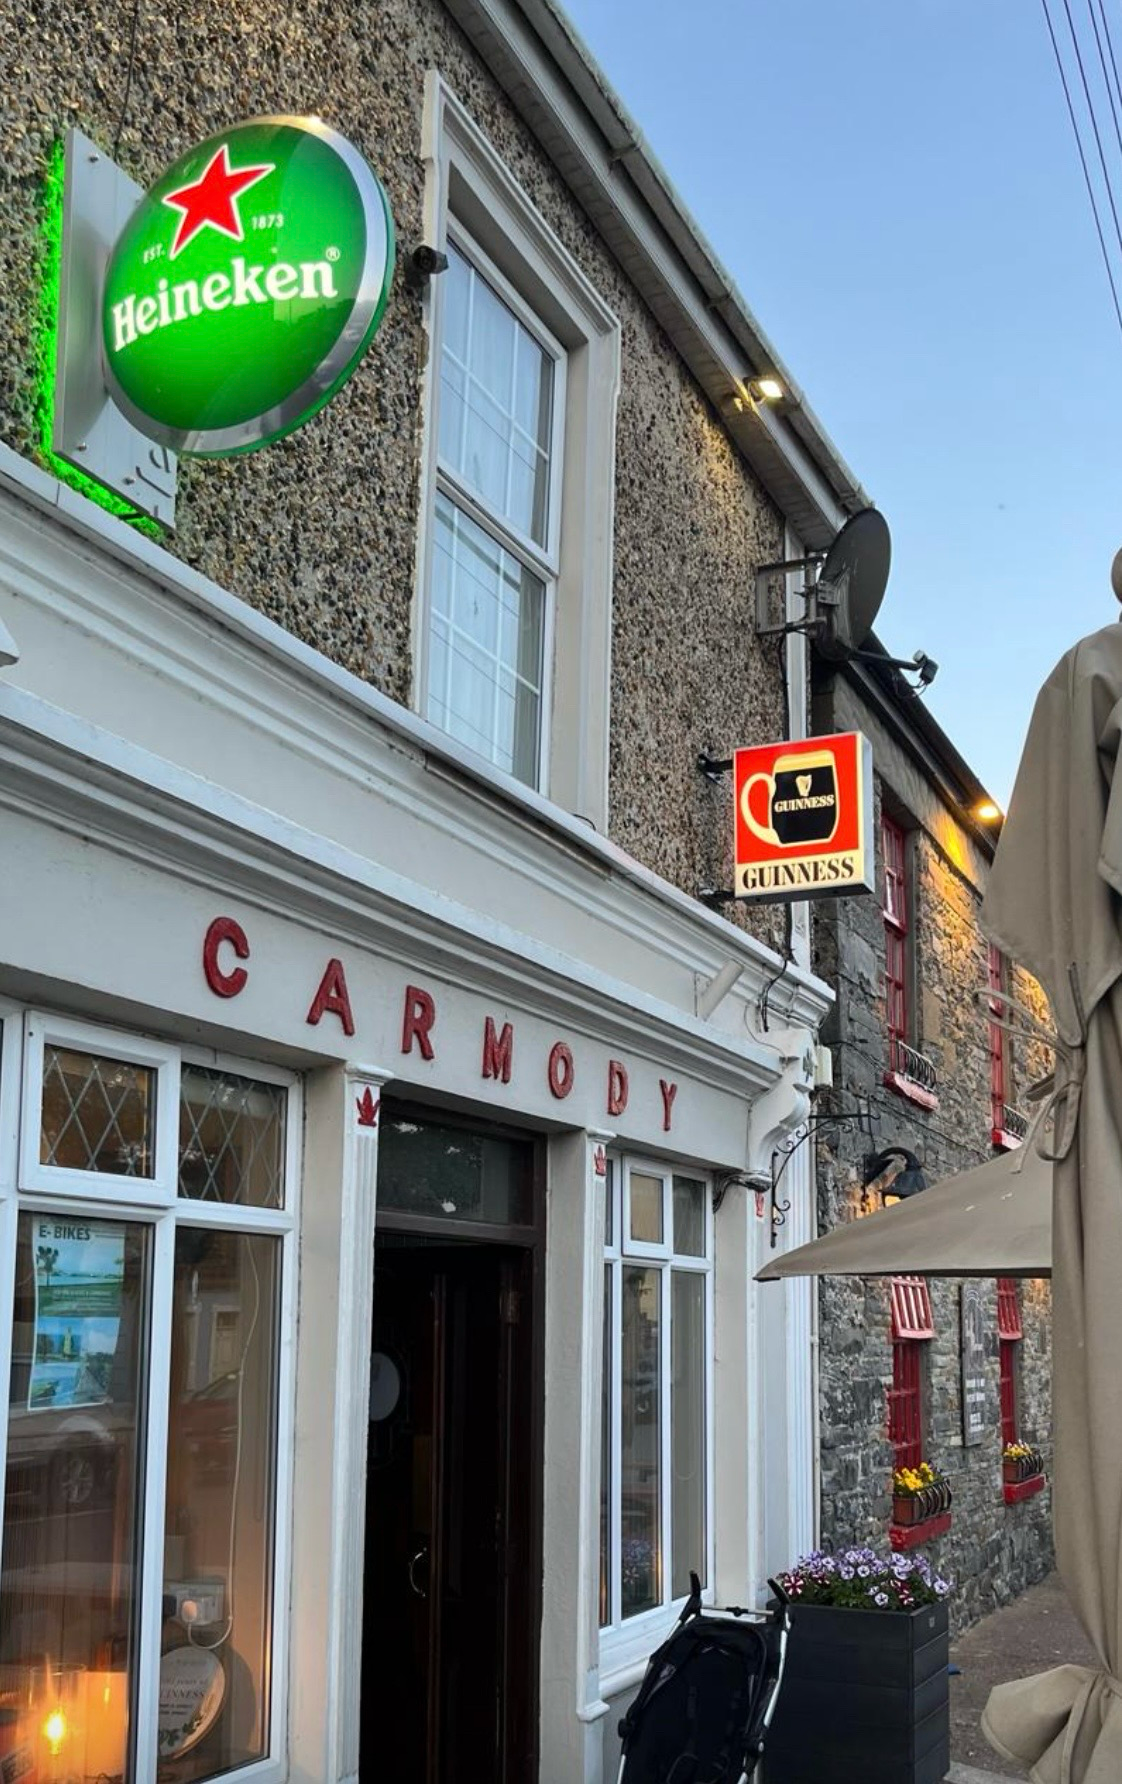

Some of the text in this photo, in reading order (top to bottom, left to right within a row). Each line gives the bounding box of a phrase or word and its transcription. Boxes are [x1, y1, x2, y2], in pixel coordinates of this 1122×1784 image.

[252, 214, 284, 230] 1873
[143, 244, 166, 264] EST.
[774, 794, 835, 813] GUINNESS
[742, 856, 855, 890] GUINNESS
[203, 916, 678, 1132] CARMODY
